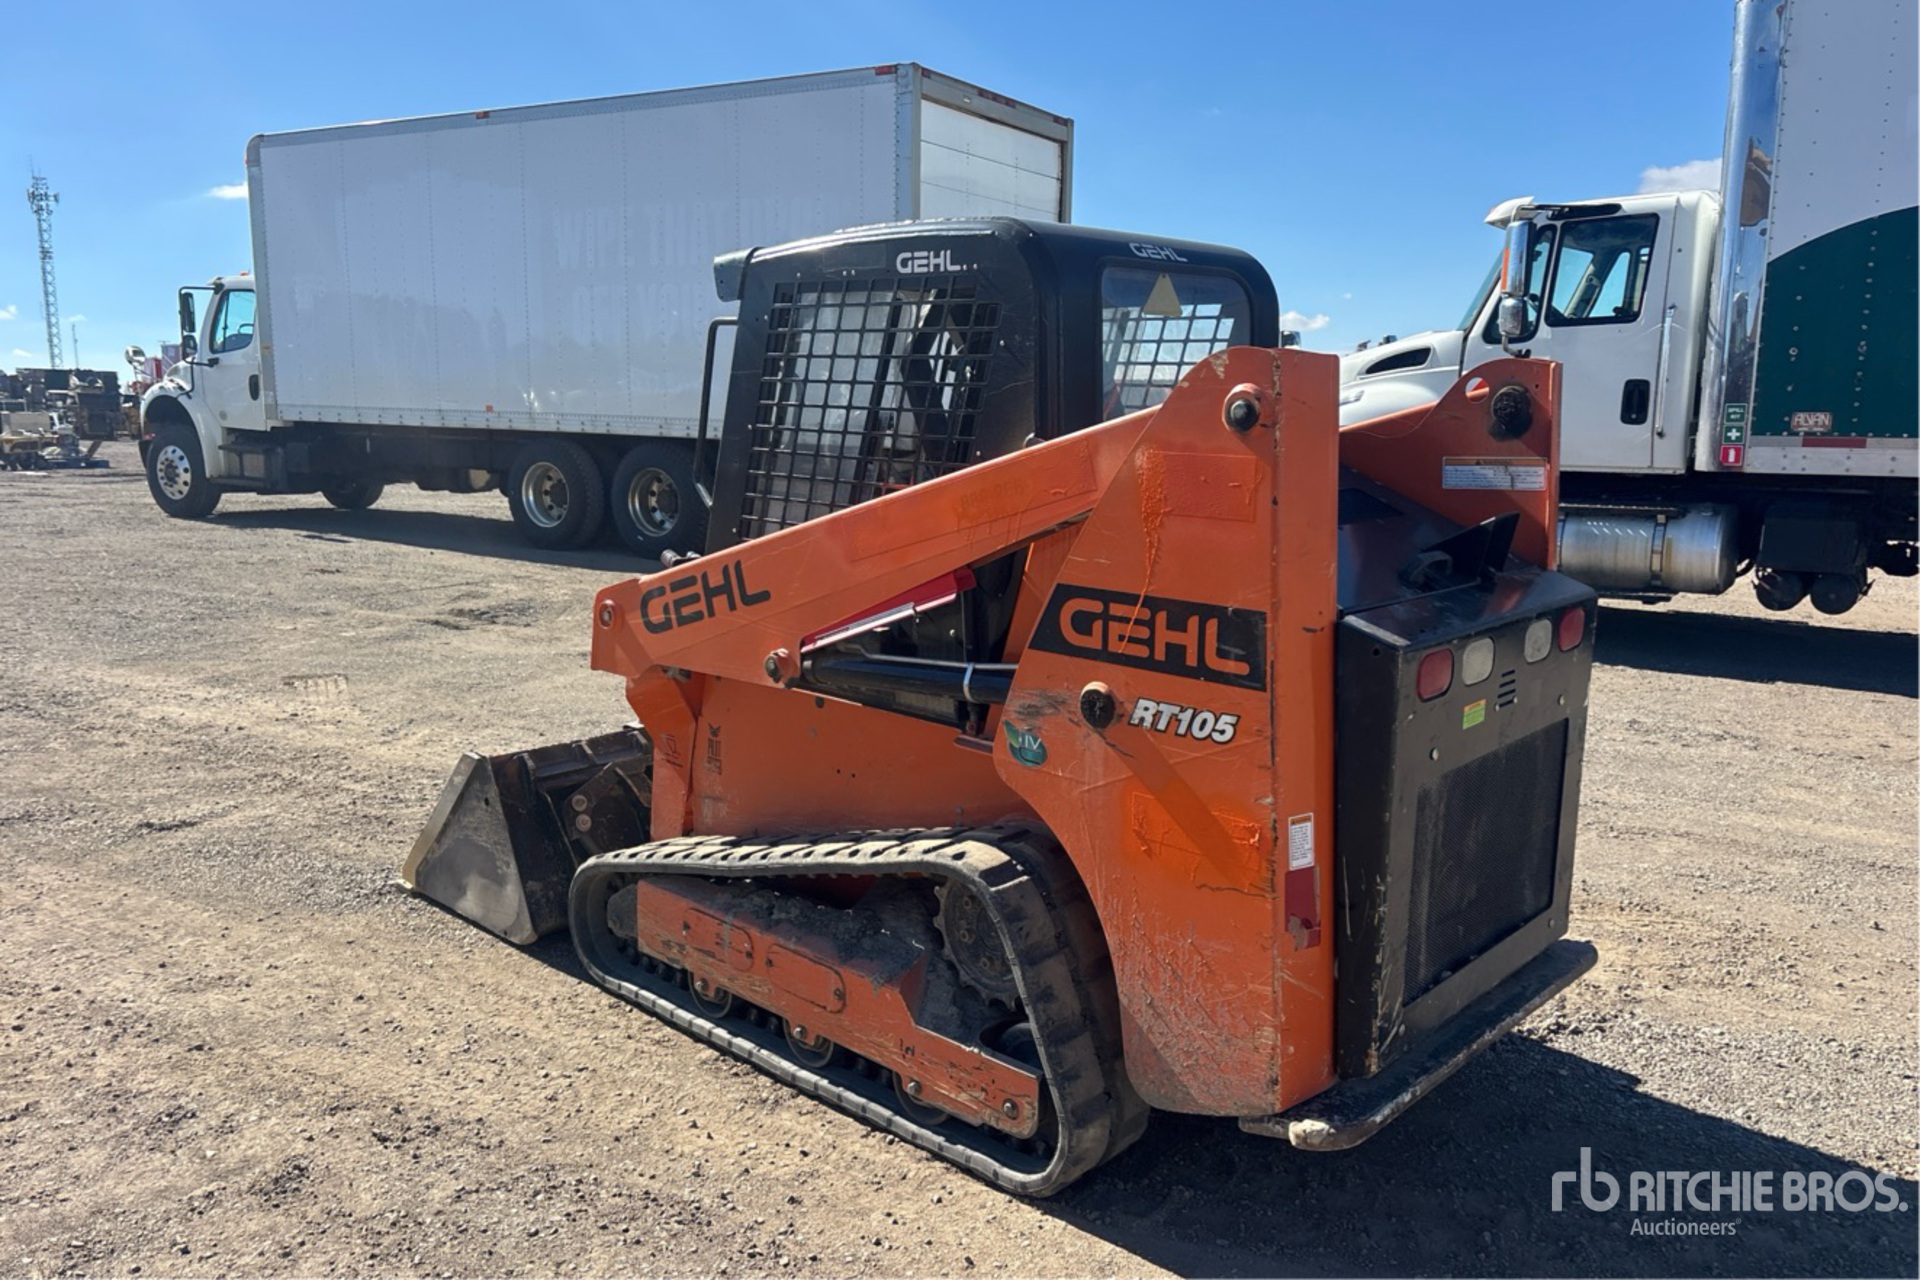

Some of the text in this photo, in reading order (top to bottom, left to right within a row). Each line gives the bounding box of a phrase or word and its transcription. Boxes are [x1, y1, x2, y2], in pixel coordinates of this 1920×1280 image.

[896, 249, 961, 274] GEHL
[1128, 242, 1189, 262] GEHL
[640, 560, 771, 634] GEHL
[1059, 597, 1250, 676] GEHL
[1128, 698, 1240, 744] RT105
